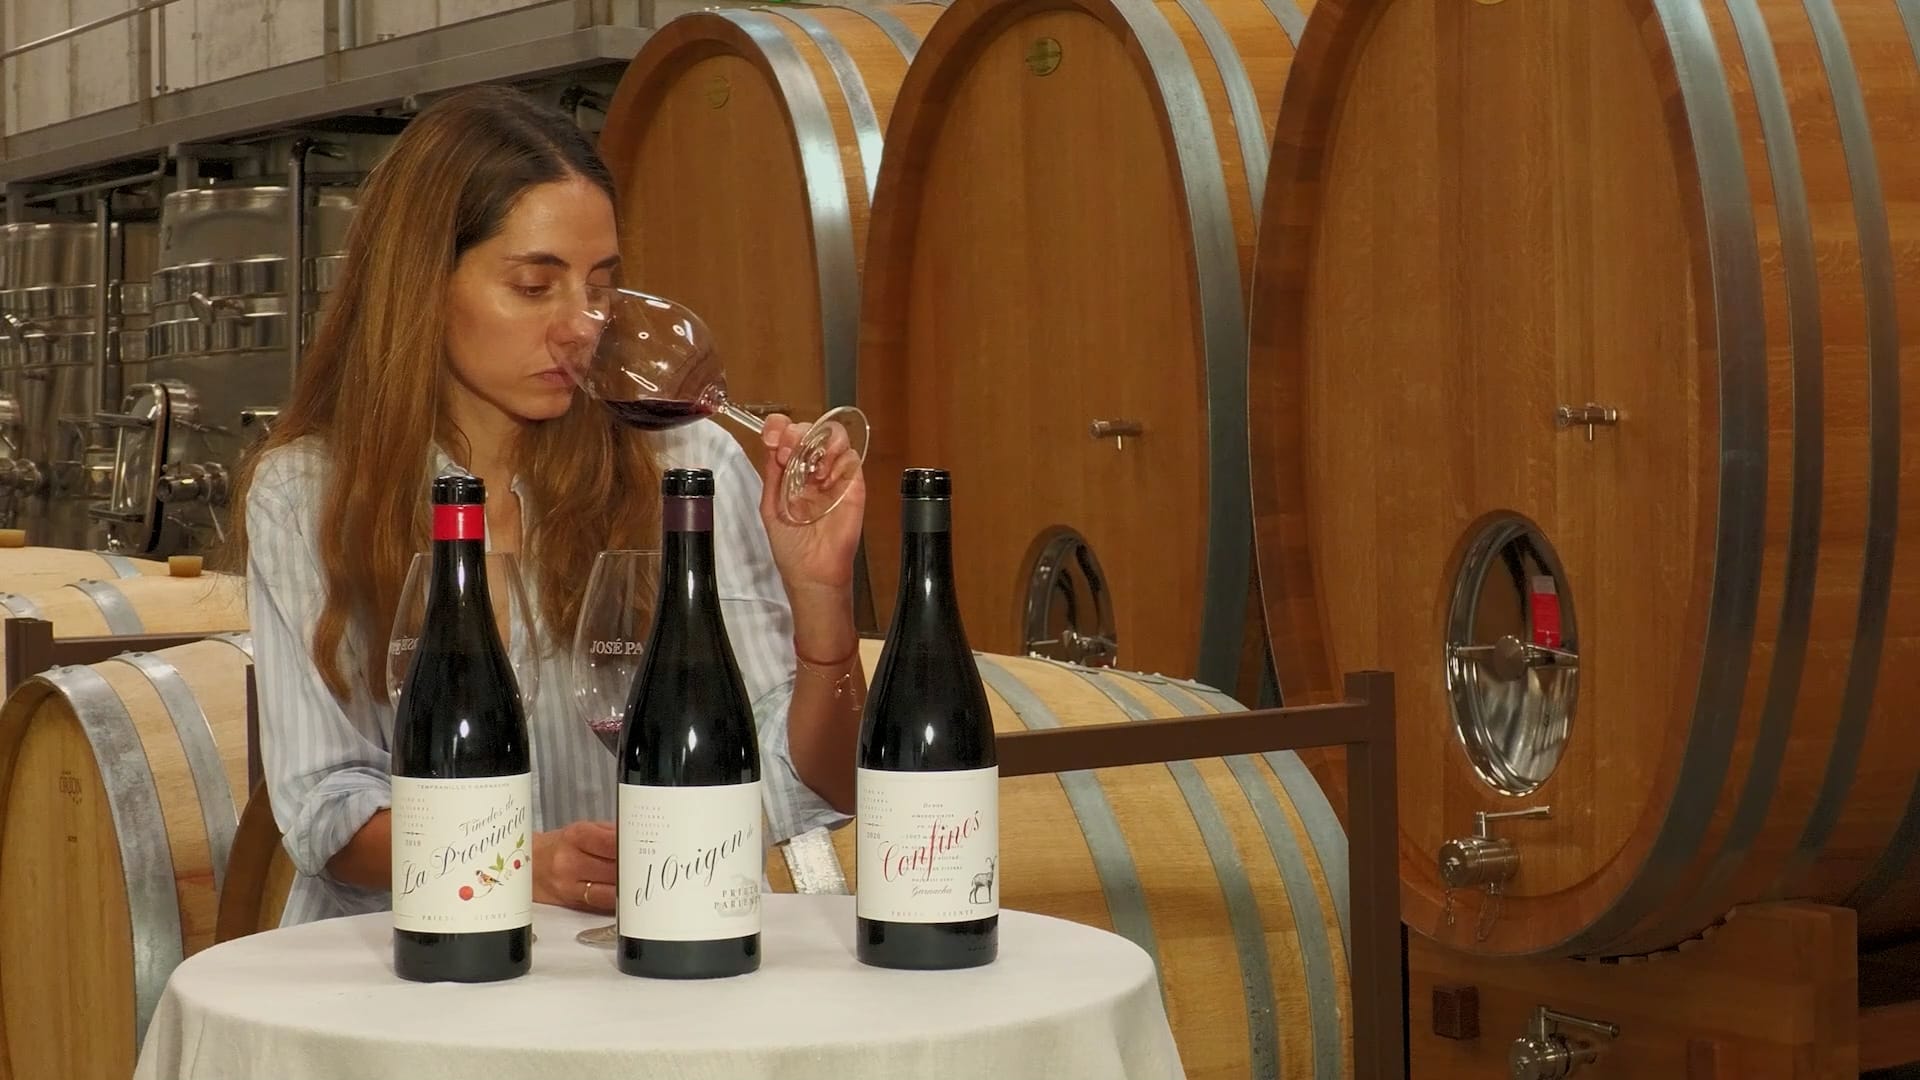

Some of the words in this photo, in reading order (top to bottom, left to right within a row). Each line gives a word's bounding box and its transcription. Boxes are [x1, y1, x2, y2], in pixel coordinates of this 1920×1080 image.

[590, 638, 623, 655] JOSÉ
[398, 859, 426, 901] La
[430, 806, 526, 880] Provincia
[634, 863, 654, 907] el
[660, 829, 743, 890] Origen
[877, 809, 985, 883] Confines
